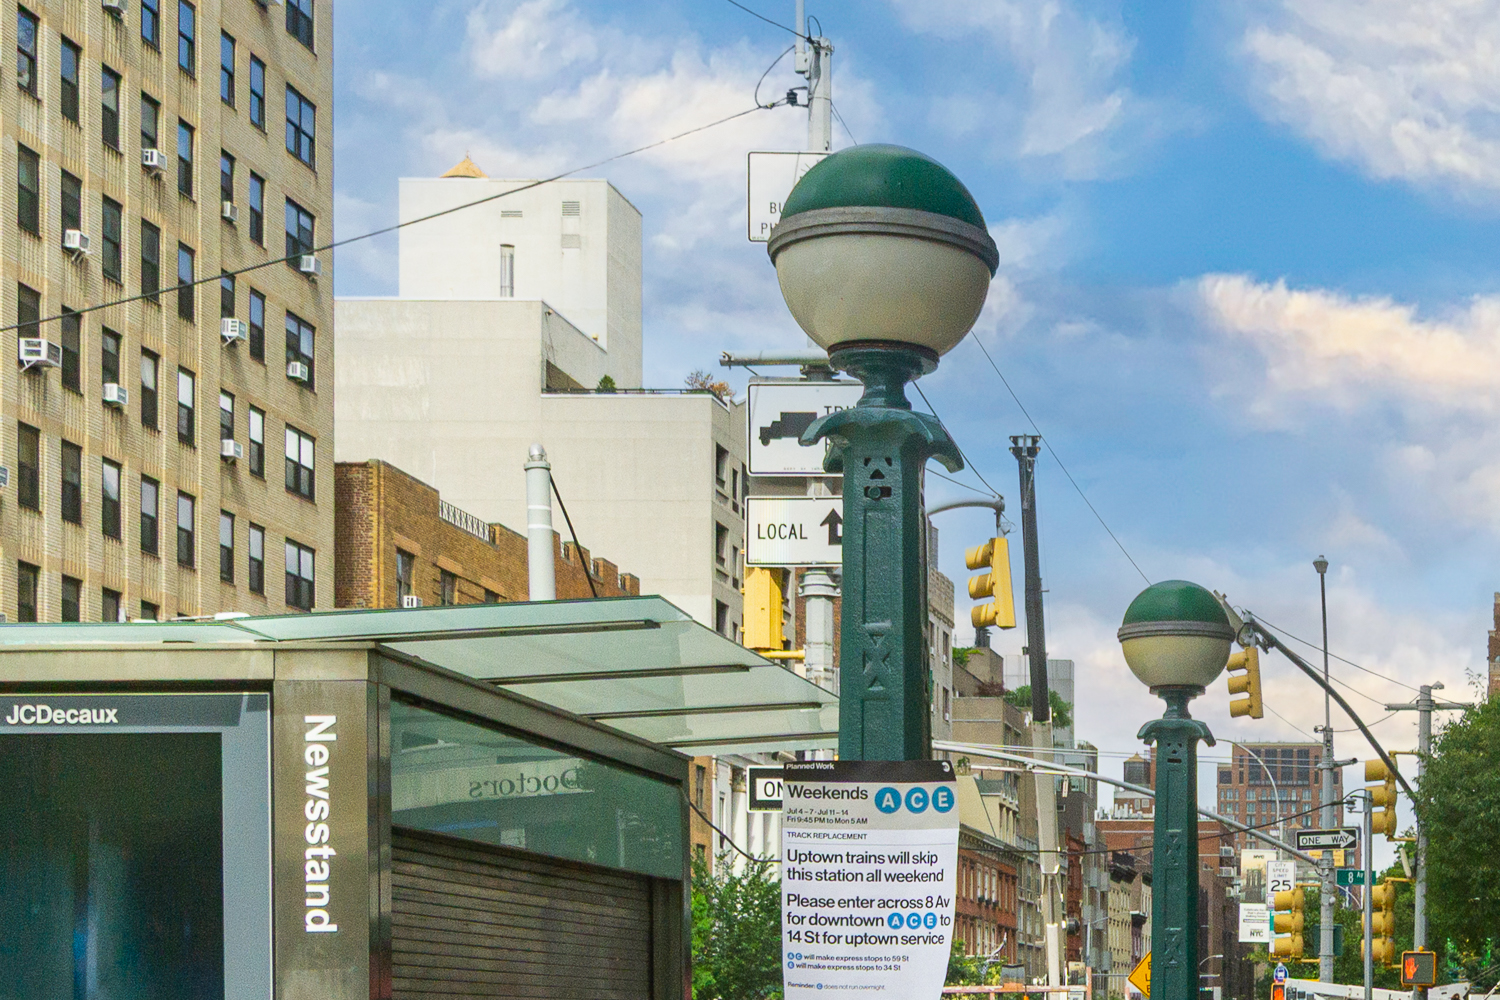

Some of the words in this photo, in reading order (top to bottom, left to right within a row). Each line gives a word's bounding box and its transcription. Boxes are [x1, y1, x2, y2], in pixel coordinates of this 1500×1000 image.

[770, 202, 785, 214] BU
[757, 524, 808, 540] LOCAL
[5, 704, 119, 726] JCDecaux
[764, 781, 783, 798] ON
[788, 785, 868, 800] Weekends
[882, 793, 895, 808] A
[910, 793, 924, 808] C
[938, 792, 948, 807] E
[303, 714, 337, 932] Newsstand
[787, 849, 843, 865] Uptown
[846, 852, 886, 864] trains
[888, 852, 910, 864] will
[912, 852, 938, 866] skip
[787, 867, 814, 881] this
[815, 869, 864, 882] station
[866, 869, 882, 882] all
[885, 869, 944, 883] weekend
[1348, 872, 1354, 884] 8
[1271, 879, 1292, 892] 25
[787, 894, 835, 908] Please
[838, 896, 875, 908] enter
[878, 898, 924, 909] across
[925, 896, 934, 908] 8
[935, 895, 950, 908] Av
[787, 912, 806, 925] for
[809, 913, 884, 927] downtown
[940, 915, 950, 926] to
[787, 930, 802, 943] 14
[804, 931, 820, 944] St
[823, 931, 842, 944] for
[845, 933, 898, 947] uptown
[901, 932, 945, 945] service
